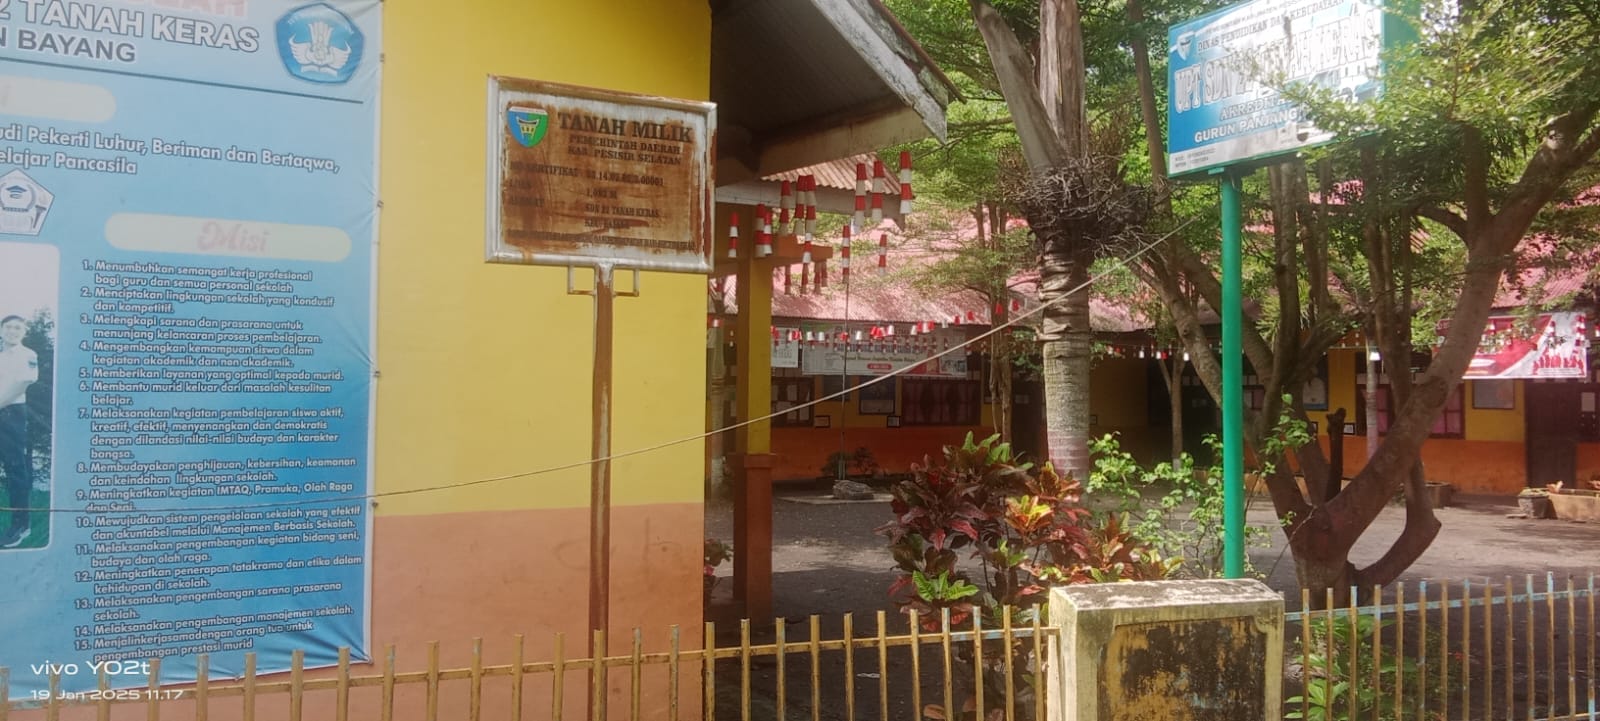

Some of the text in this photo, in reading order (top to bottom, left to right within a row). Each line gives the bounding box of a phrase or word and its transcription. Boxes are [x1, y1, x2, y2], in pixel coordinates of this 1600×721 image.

[20, 0, 144, 38] TANAH
[152, 14, 259, 52] KERAS
[18, 28, 136, 62] BAYANG
[1175, 63, 1202, 114] UPT
[558, 111, 693, 143] TANAH MILIK
[1194, 108, 1299, 143] GURUN PANJANG
[27, 126, 340, 174] Pekerti Luhur, Beriman dan Bertaqwa,
[640, 142, 681, 154] DAERAH
[54, 152, 137, 175] Pancasila
[594, 149, 634, 161] PESISIR
[638, 153, 681, 165] SELATAN
[197, 221, 271, 252] Misi
[95, 261, 311, 280] Menumbuhkan semangat kerja profesional
[95, 275, 292, 292] bagi guru semua personal sekolah
[95, 288, 334, 307] Menciptakan lingkungan sekolah yang kondusif
[95, 302, 173, 314] dan kompetitif.
[95, 315, 157, 328] Melengkapi
[199, 318, 219, 327] dan
[222, 320, 273, 330] prasarana
[94, 330, 321, 344] menunjang kelancaran proses pembelajaran.
[93, 342, 312, 355] Mengembangkan kemampuan siswa dalam
[94, 356, 293, 367] kegiatan akademik akademik.
[93, 368, 343, 382] Memberikan layanan yang optimal kepada murid.
[93, 382, 330, 392] Membantu murid keluar dari masalah kesulitan
[92, 395, 133, 407] belajar.
[92, 408, 344, 420] Melaksanakan kegiatan pembelajaran siswa aktif,
[91, 420, 327, 432] kreatif, efektif, menyenangkan dan demokratis
[91, 433, 338, 447] dengan dilandasi nilai-nilai budaya dan karakter
[91, 449, 133, 460] bangsa.
[91, 457, 356, 472] Membudayakan penghijauan, kebersihan, keamanan
[115, 472, 277, 485] keindahan lingkungan sekolah.
[91, 483, 352, 500] Meningkatkan kegiatan IMTAQ, Pramuka, Olah Raga
[95, 506, 360, 527] Mewujudkan sistem pengelolaan sekolah yang efektif
[92, 519, 355, 540] dan akuntabel melalui Manajemen Berbasis Sekolah.
[95, 532, 359, 552] Melaksanakan pengembangan kegiatan bidang seni,
[92, 553, 211, 567] budaya olah raga.
[95, 567, 171, 580] Meningkatkan
[175, 565, 229, 577] penerapan
[307, 557, 330, 567] etika
[333, 556, 361, 565] dalam
[95, 578, 210, 593] kehidupan sekolah.
[95, 583, 341, 606] Melaksanakan pengembangan sarana prasarana
[95, 609, 139, 620] sekolah.
[95, 605, 353, 634] Melaksanakan pengembangan manajemen sekolah.
[236, 626, 265, 636] orang
[95, 640, 252, 663] pengembangan prestasi murid
